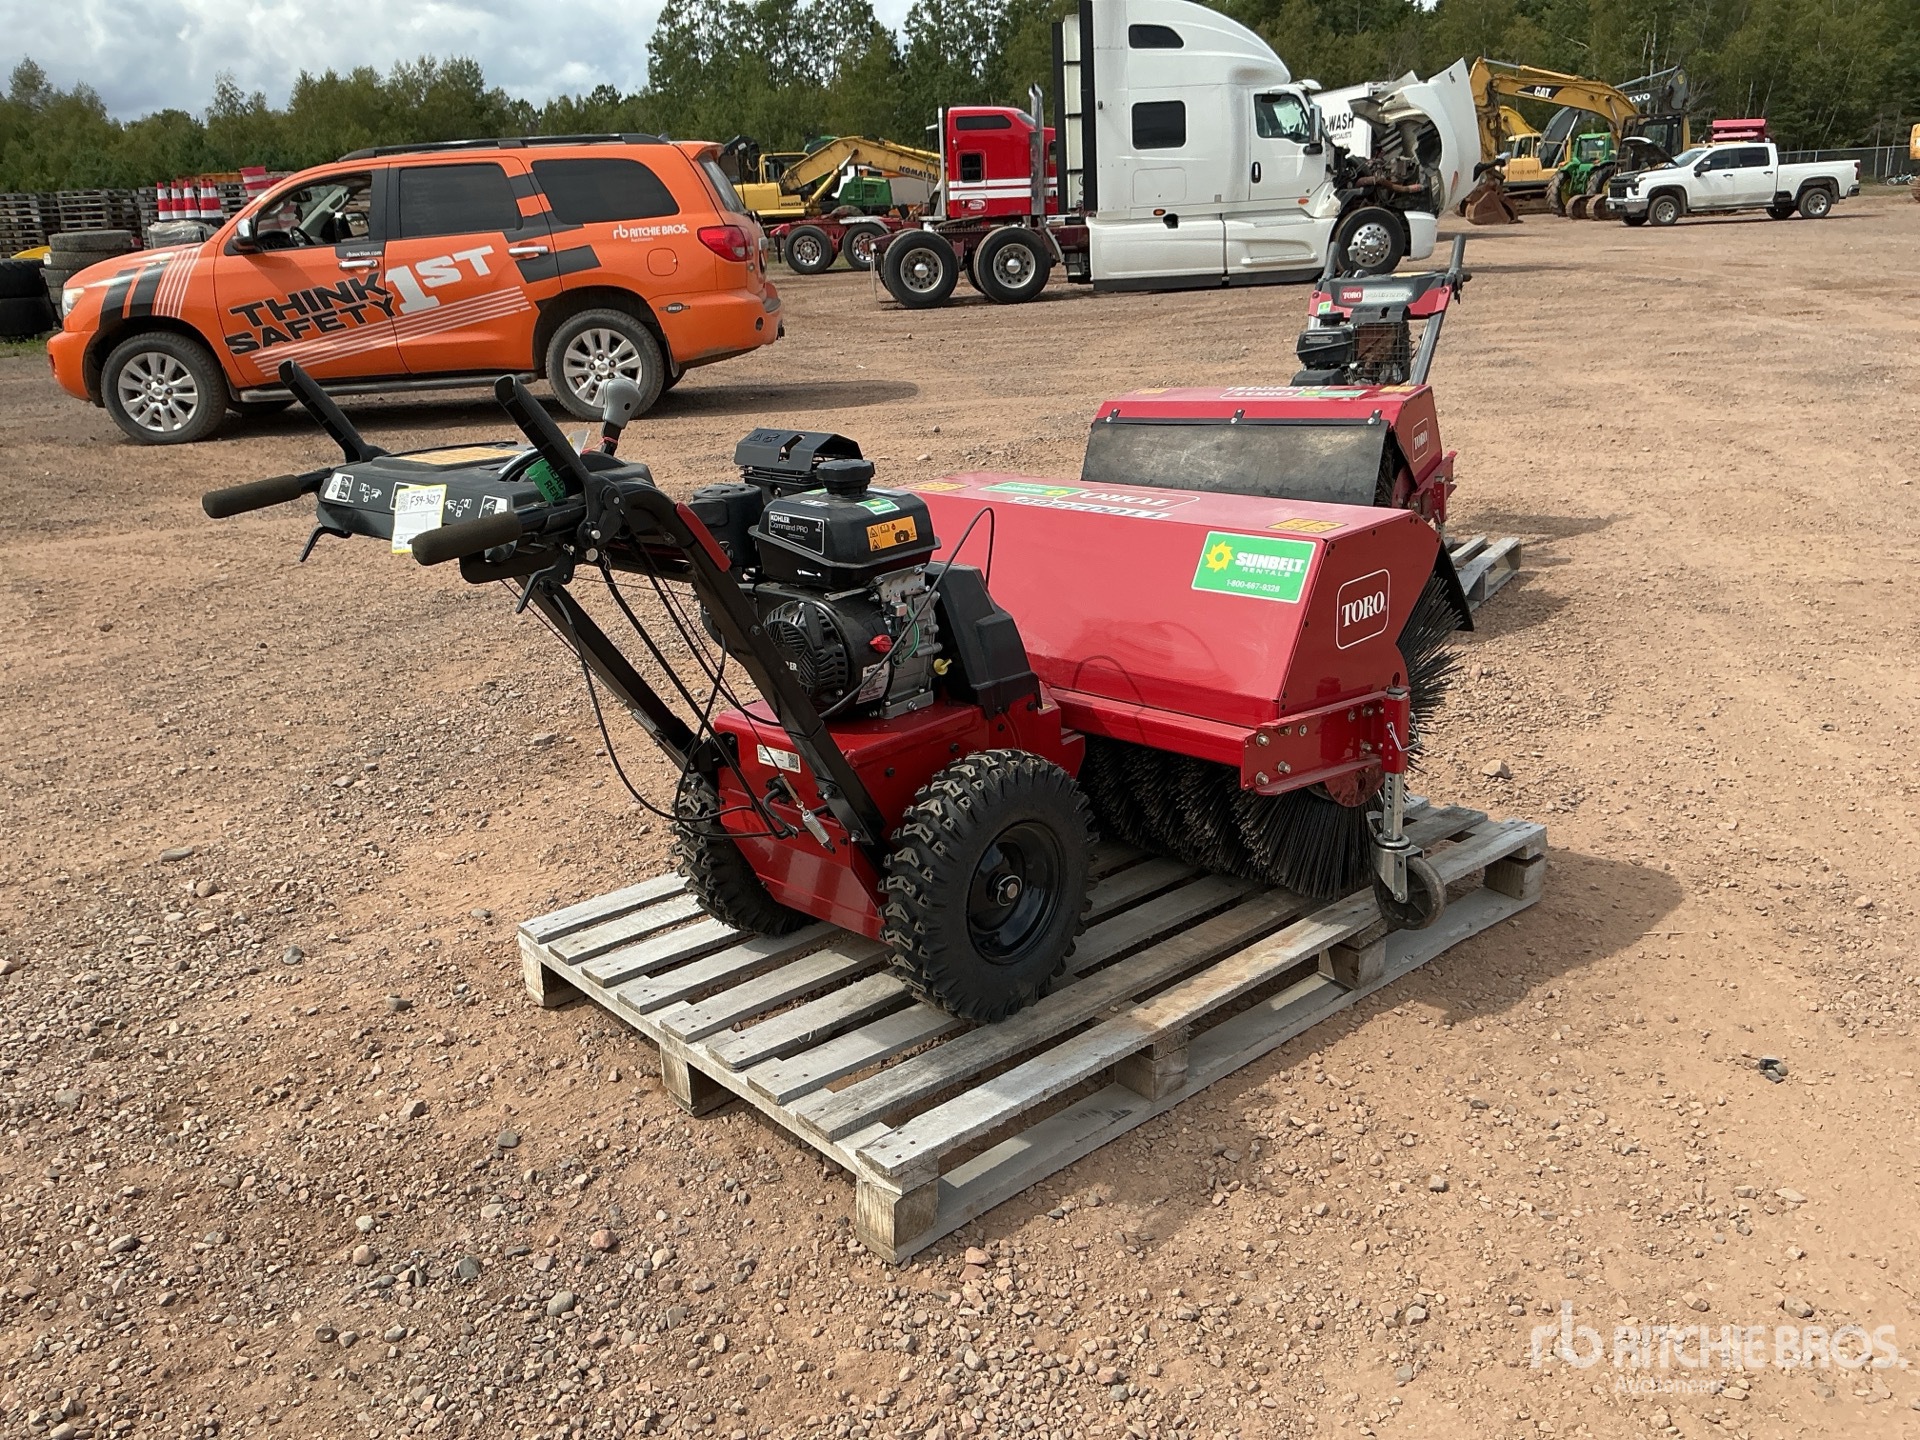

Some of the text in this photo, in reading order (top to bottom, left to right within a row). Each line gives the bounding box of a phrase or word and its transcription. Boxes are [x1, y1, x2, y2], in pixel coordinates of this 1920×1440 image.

[1534, 86, 1551, 98] CAT
[1628, 93, 1650, 103] LVO
[629, 226, 661, 238] RITCHIE
[661, 224, 689, 235] BROS.
[385, 244, 494, 314] 1ST
[229, 272, 393, 327] THINK
[1342, 291, 1362, 299] TORO
[224, 296, 396, 355] SAFETY
[1079, 491, 1170, 506] TORO
[770, 514, 790, 524] KOHLER
[770, 521, 796, 531] Command
[796, 525, 809, 534] PRO
[1235, 552, 1305, 573] SUNBELT
[1242, 567, 1291, 577] RENTALS
[1341, 591, 1385, 628] TORO
